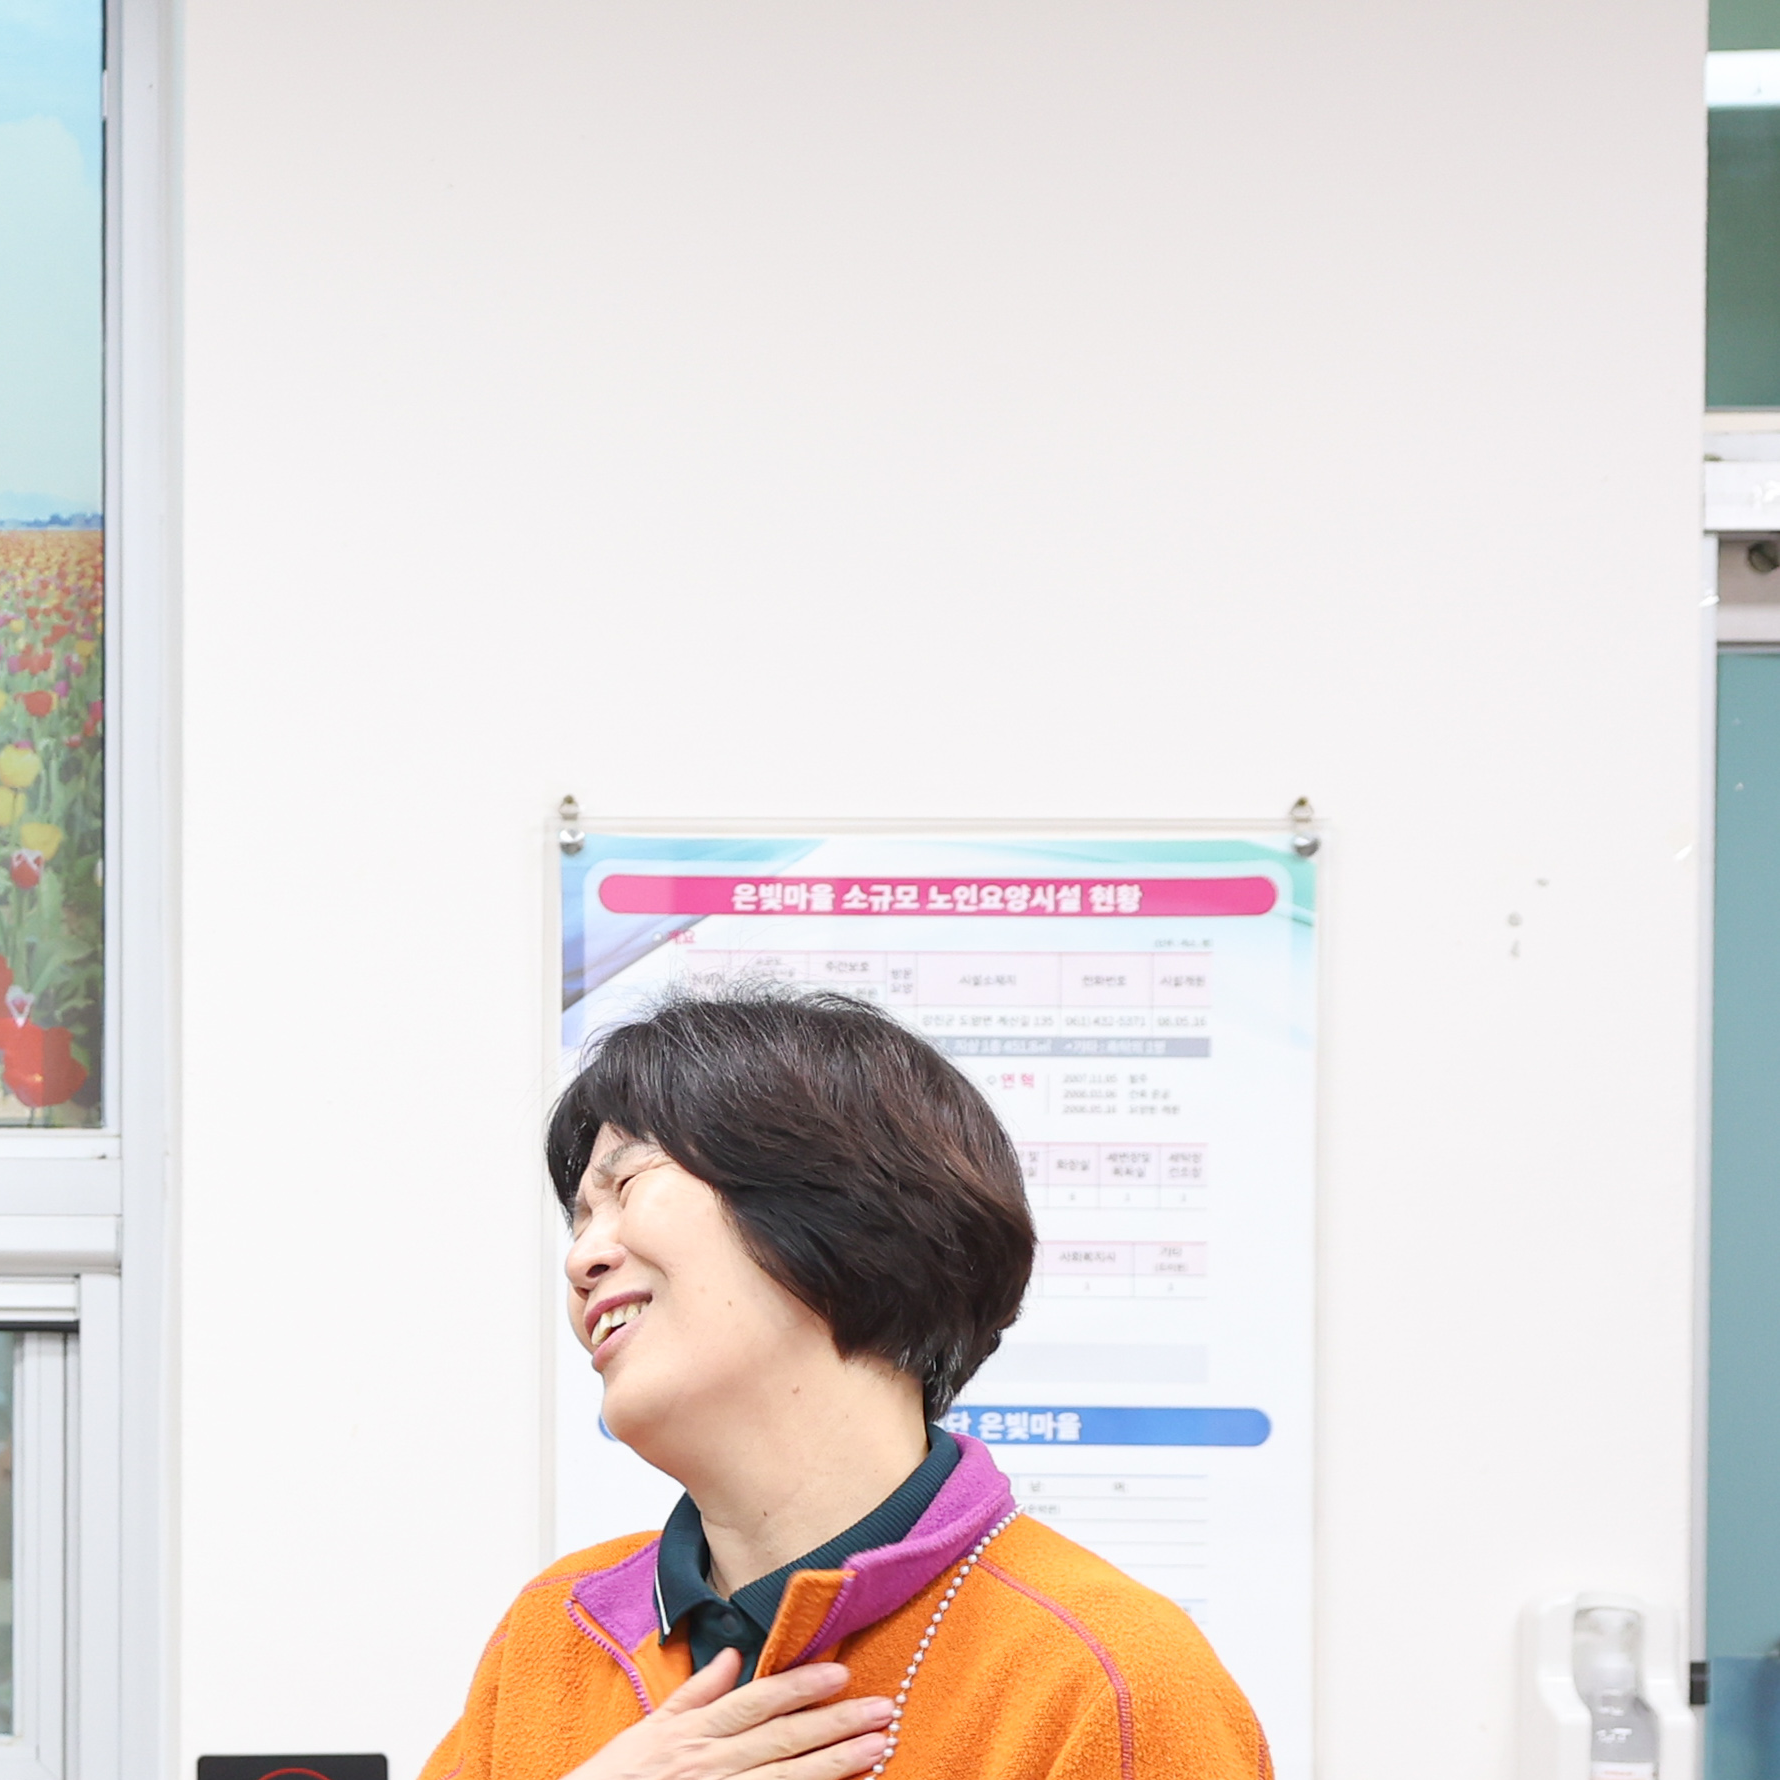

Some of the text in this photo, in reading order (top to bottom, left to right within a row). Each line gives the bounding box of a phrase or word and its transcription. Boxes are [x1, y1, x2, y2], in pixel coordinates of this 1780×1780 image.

[731, 883, 1143, 913] 은빛마을 소규모 노인요양시설 현황
[977, 1411, 1083, 1442] 은빛마을
